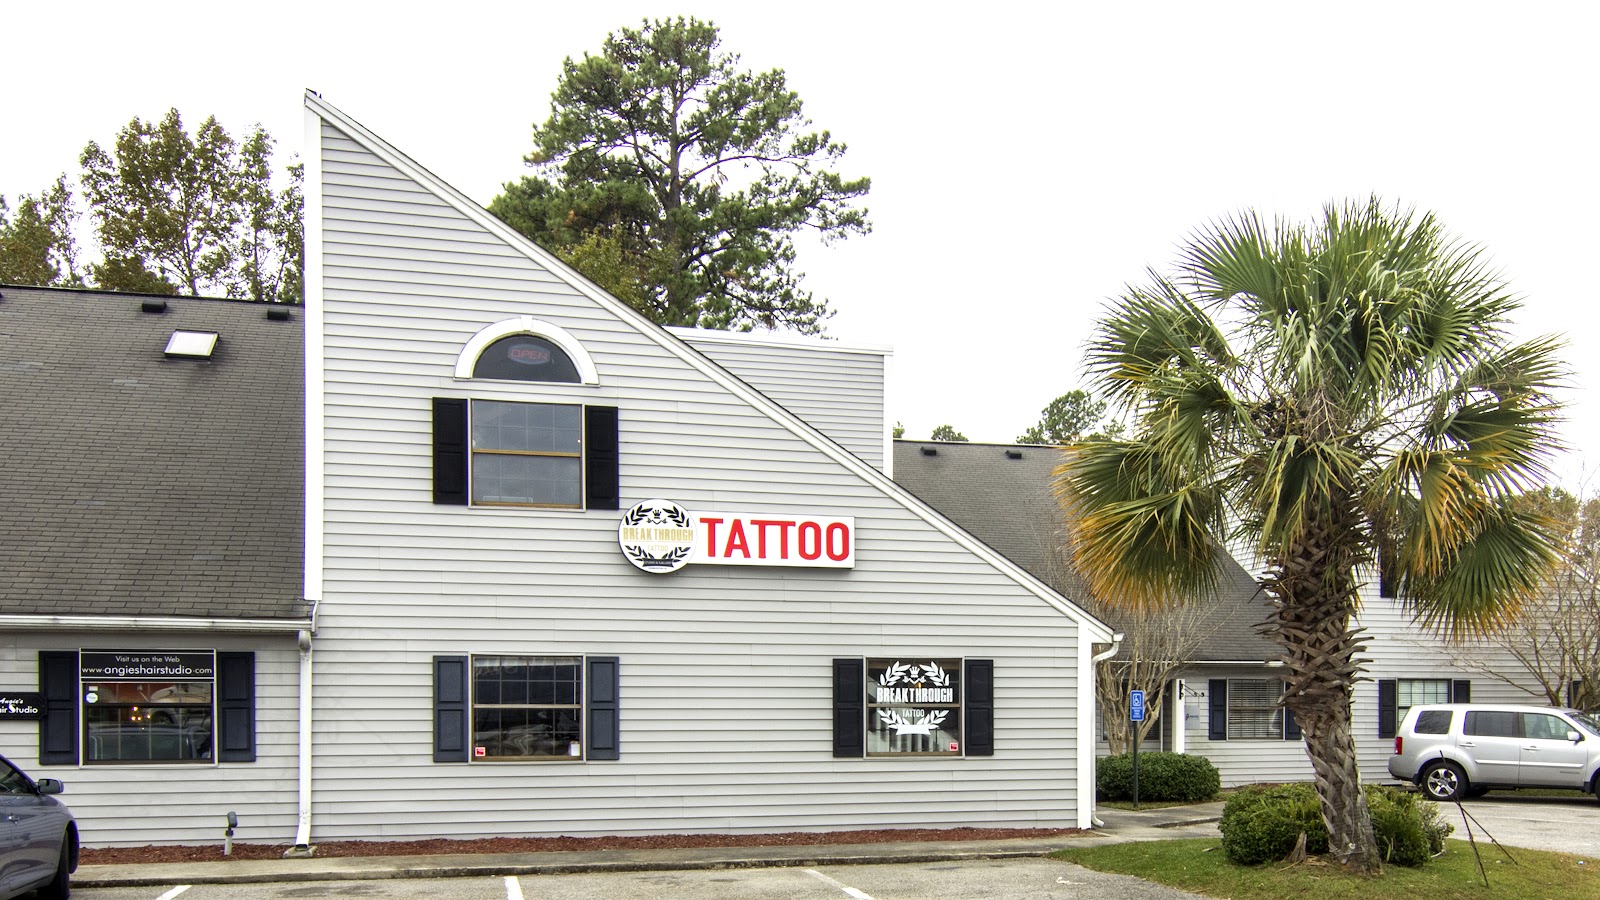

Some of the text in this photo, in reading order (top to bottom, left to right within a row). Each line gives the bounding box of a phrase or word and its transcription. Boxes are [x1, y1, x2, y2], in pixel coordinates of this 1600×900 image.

[511, 349, 549, 361] OPEN
[699, 517, 850, 562] TATTOO
[647, 544, 669, 552] TATTOO
[8, 704, 38, 714] Studio
[902, 709, 925, 718] TATTOO
